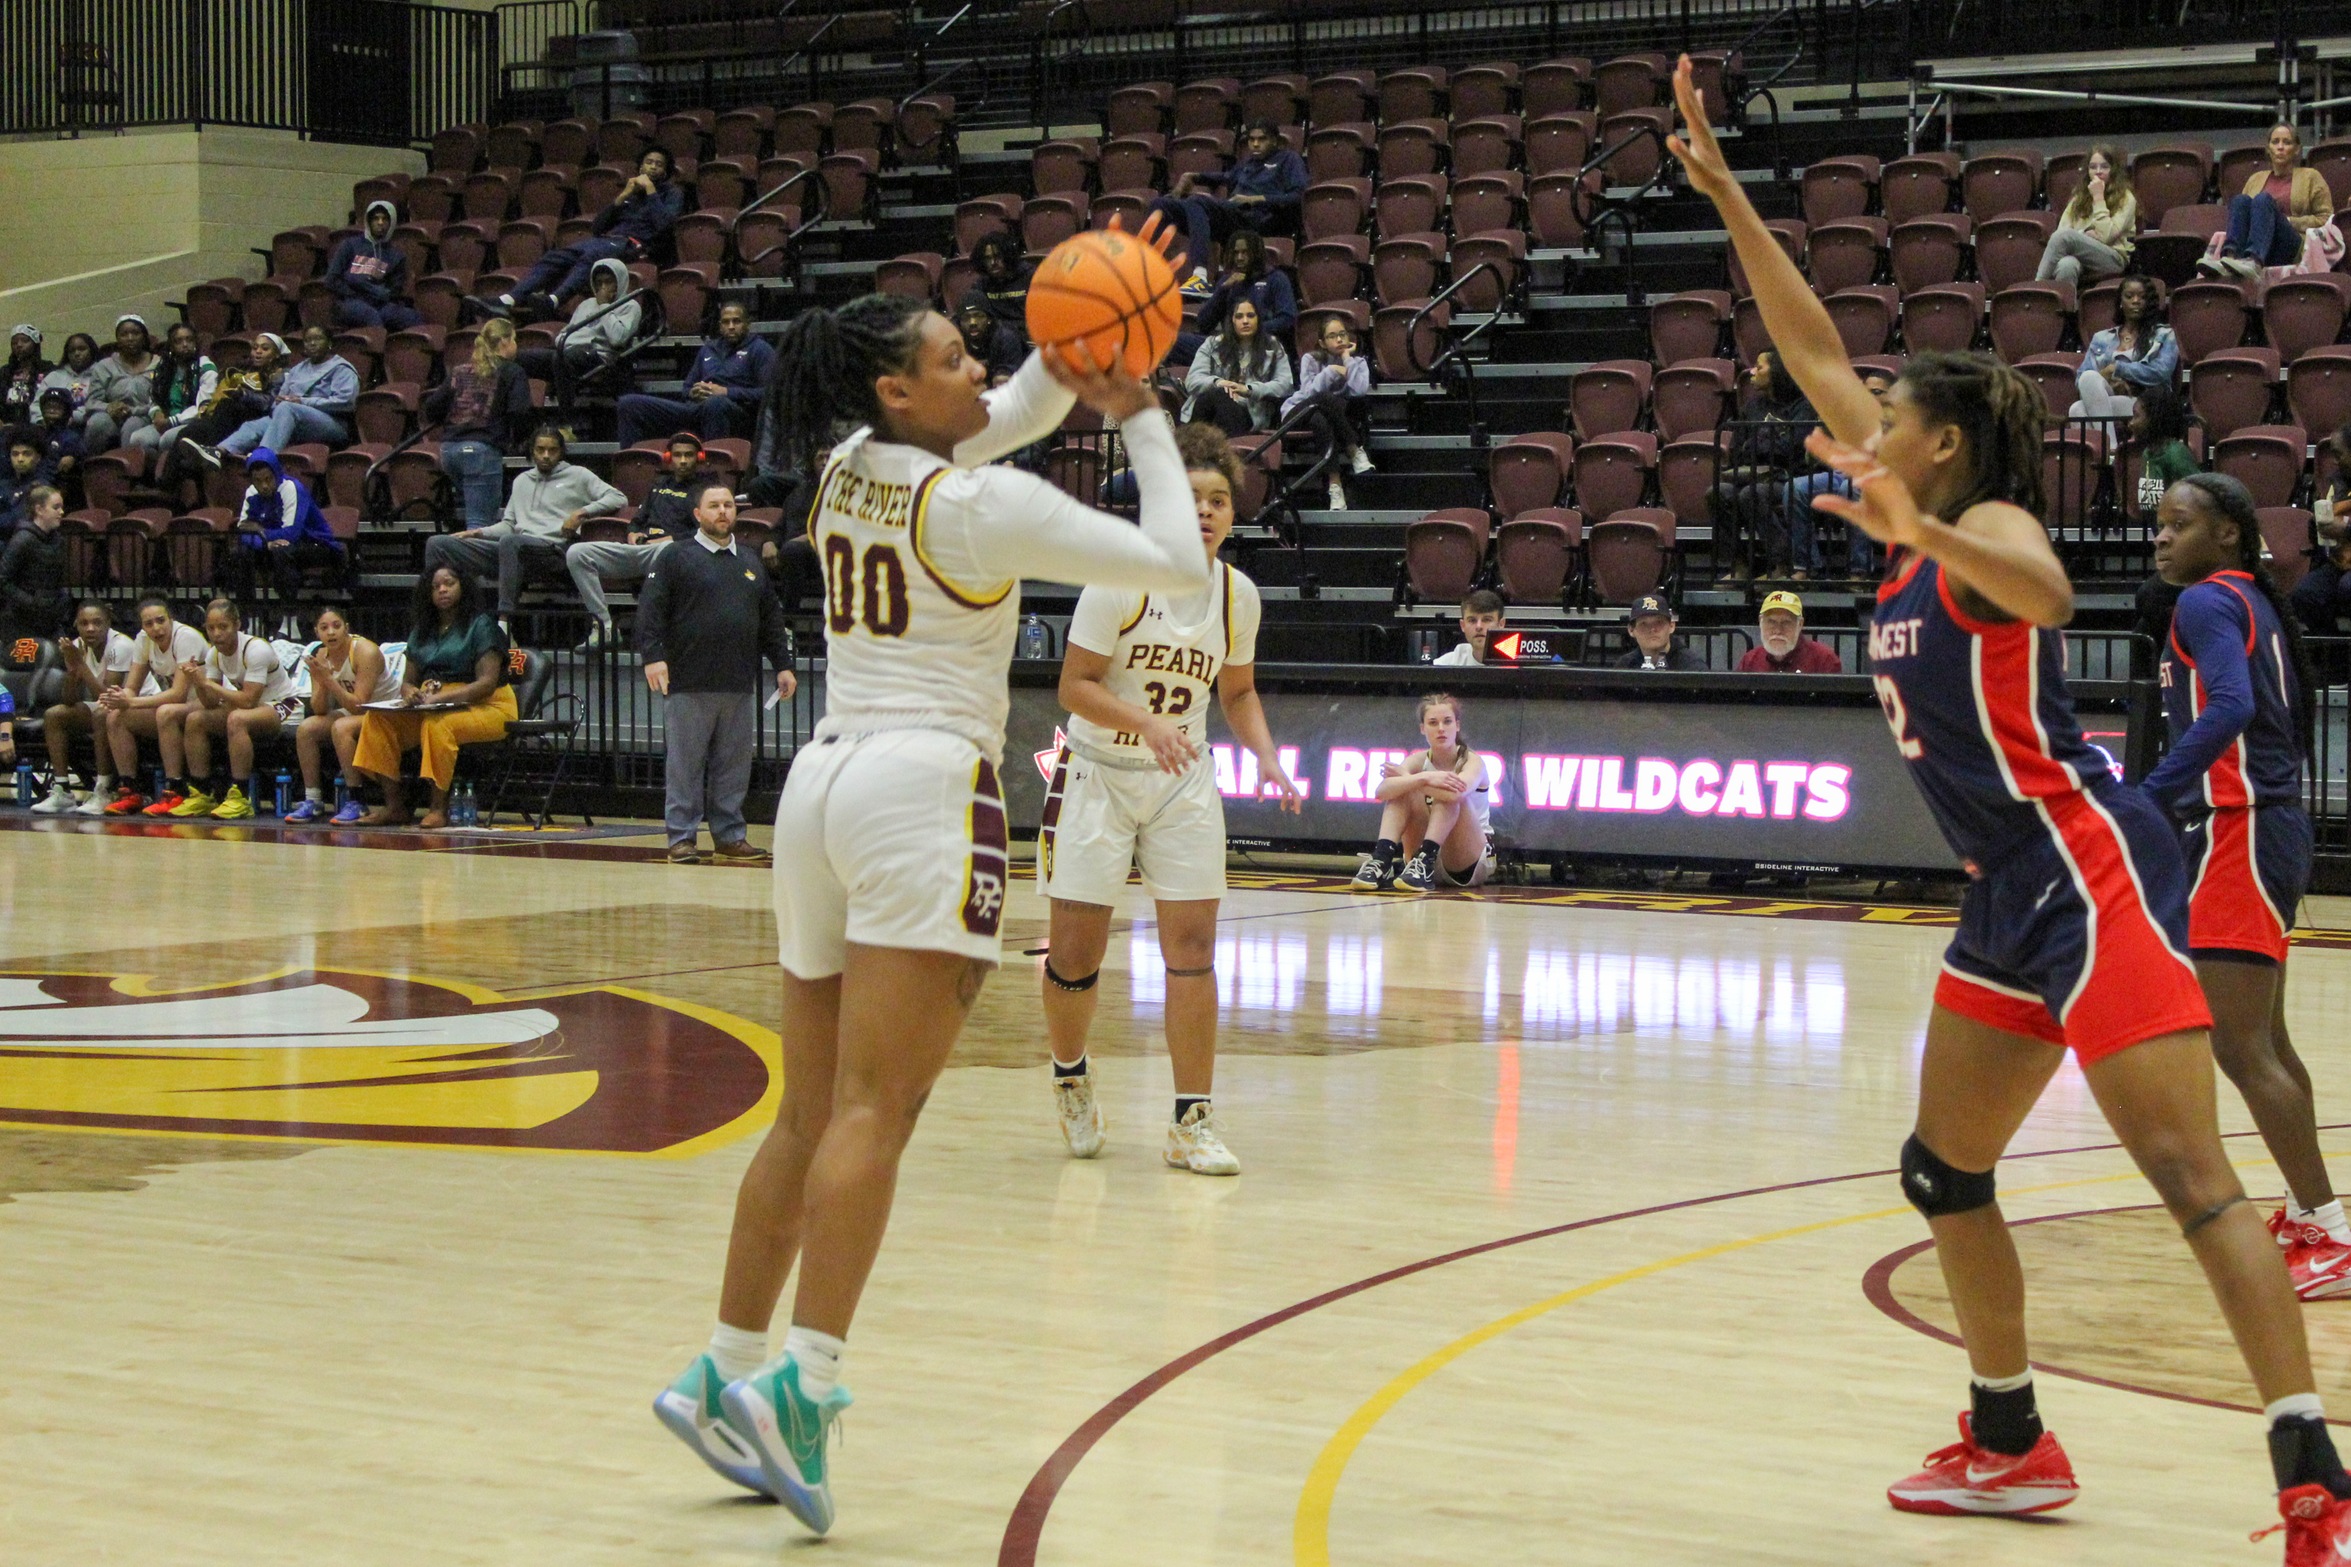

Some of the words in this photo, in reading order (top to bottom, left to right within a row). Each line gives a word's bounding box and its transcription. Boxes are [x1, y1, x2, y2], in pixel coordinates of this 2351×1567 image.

[826, 469, 863, 517] THE
[858, 480, 912, 528] RIVER
[825, 531, 910, 638] 00
[1126, 644, 1214, 686] PEARL
[1519, 640, 1549, 653] POSS.
[1145, 681, 1192, 715] 32
[1872, 674, 1924, 760] 2
[1212, 746, 1310, 799] ARL
[1523, 754, 1851, 821] WILDCATS
[1231, 839, 1271, 847] INTERACTIVE
[1794, 865, 1840, 873] INTERACTIVE
